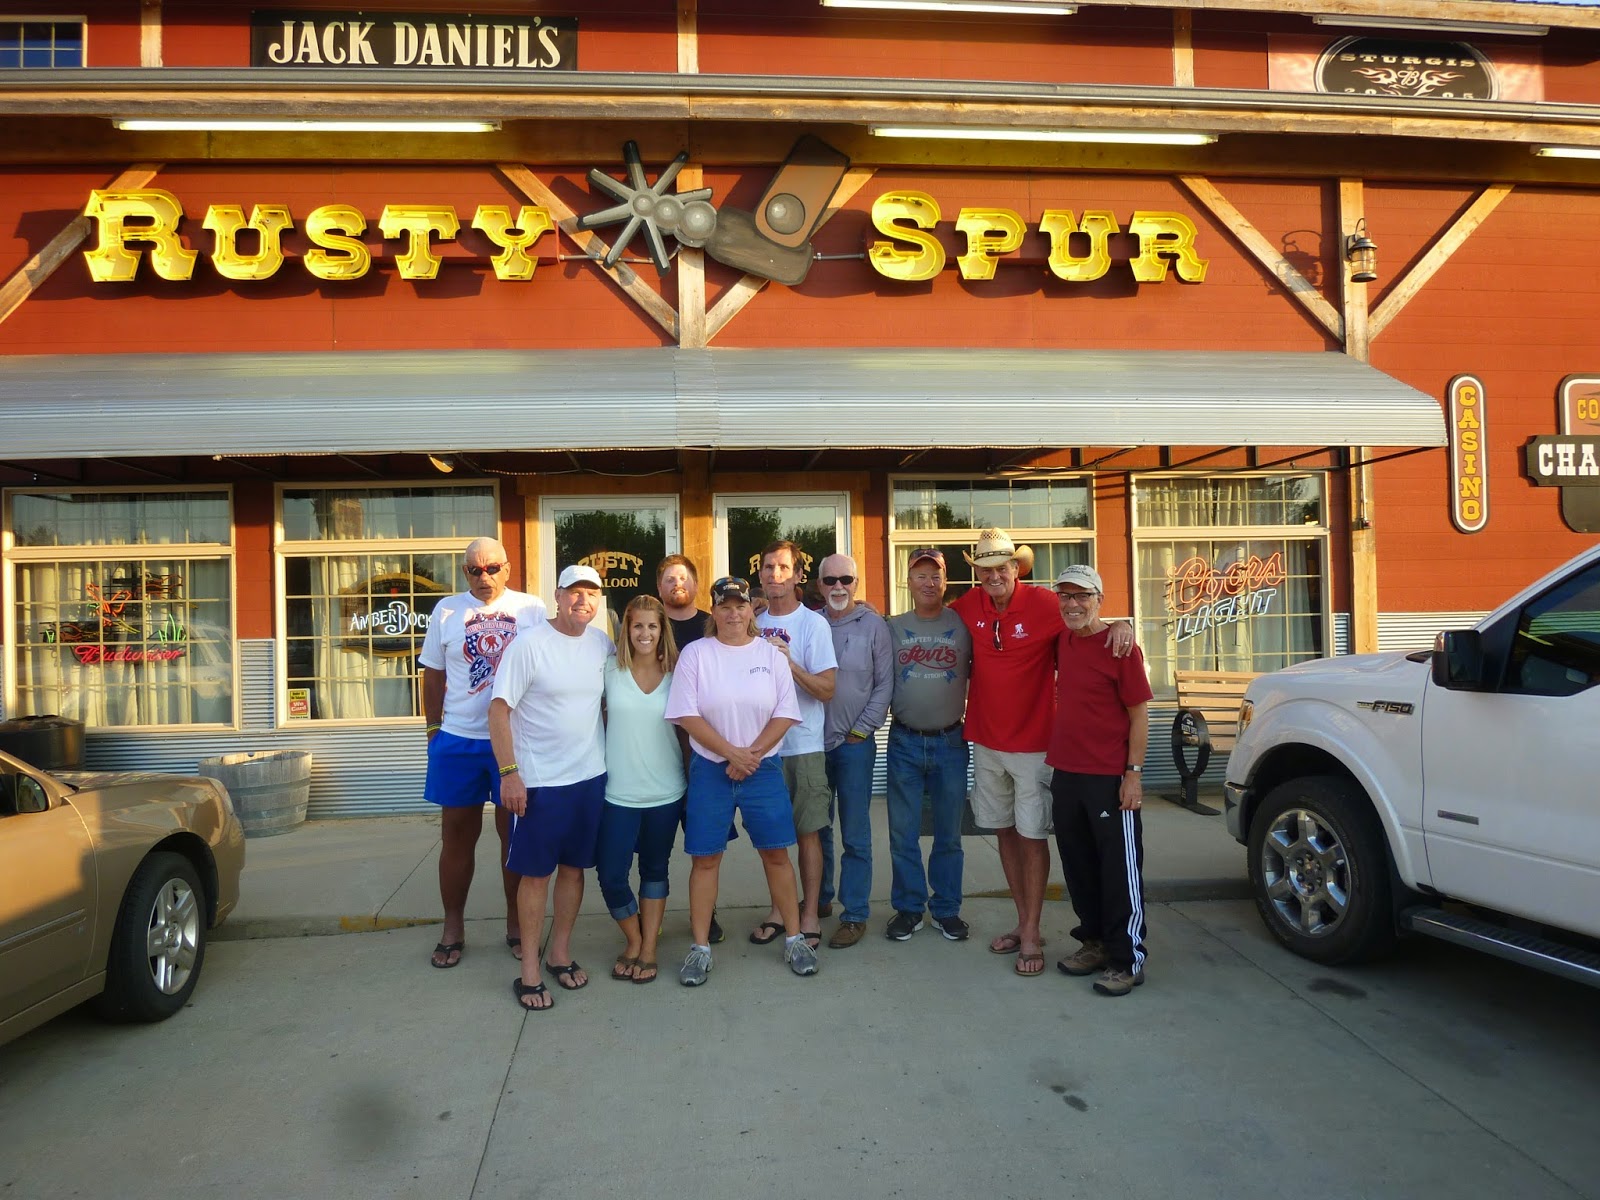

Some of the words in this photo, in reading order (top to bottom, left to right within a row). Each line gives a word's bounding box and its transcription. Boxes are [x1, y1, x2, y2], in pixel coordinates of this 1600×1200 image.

[268, 20, 379, 64] JACK
[393, 16, 561, 68] DANIEL'S
[1340, 53, 1475, 67] STURGIS
[83, 188, 556, 282] RUSTY
[869, 190, 1210, 282] SPUR
[1457, 386, 1482, 520] CASINO
[1538, 443, 1600, 477] CHA
[1167, 552, 1286, 613] Coors
[1176, 588, 1277, 642] LIGHT
[74, 644, 185, 664] Budweiser
[897, 645, 958, 669] Levi's
[901, 636, 932, 646] CRAFTED
[934, 636, 956, 646] INDIGO
